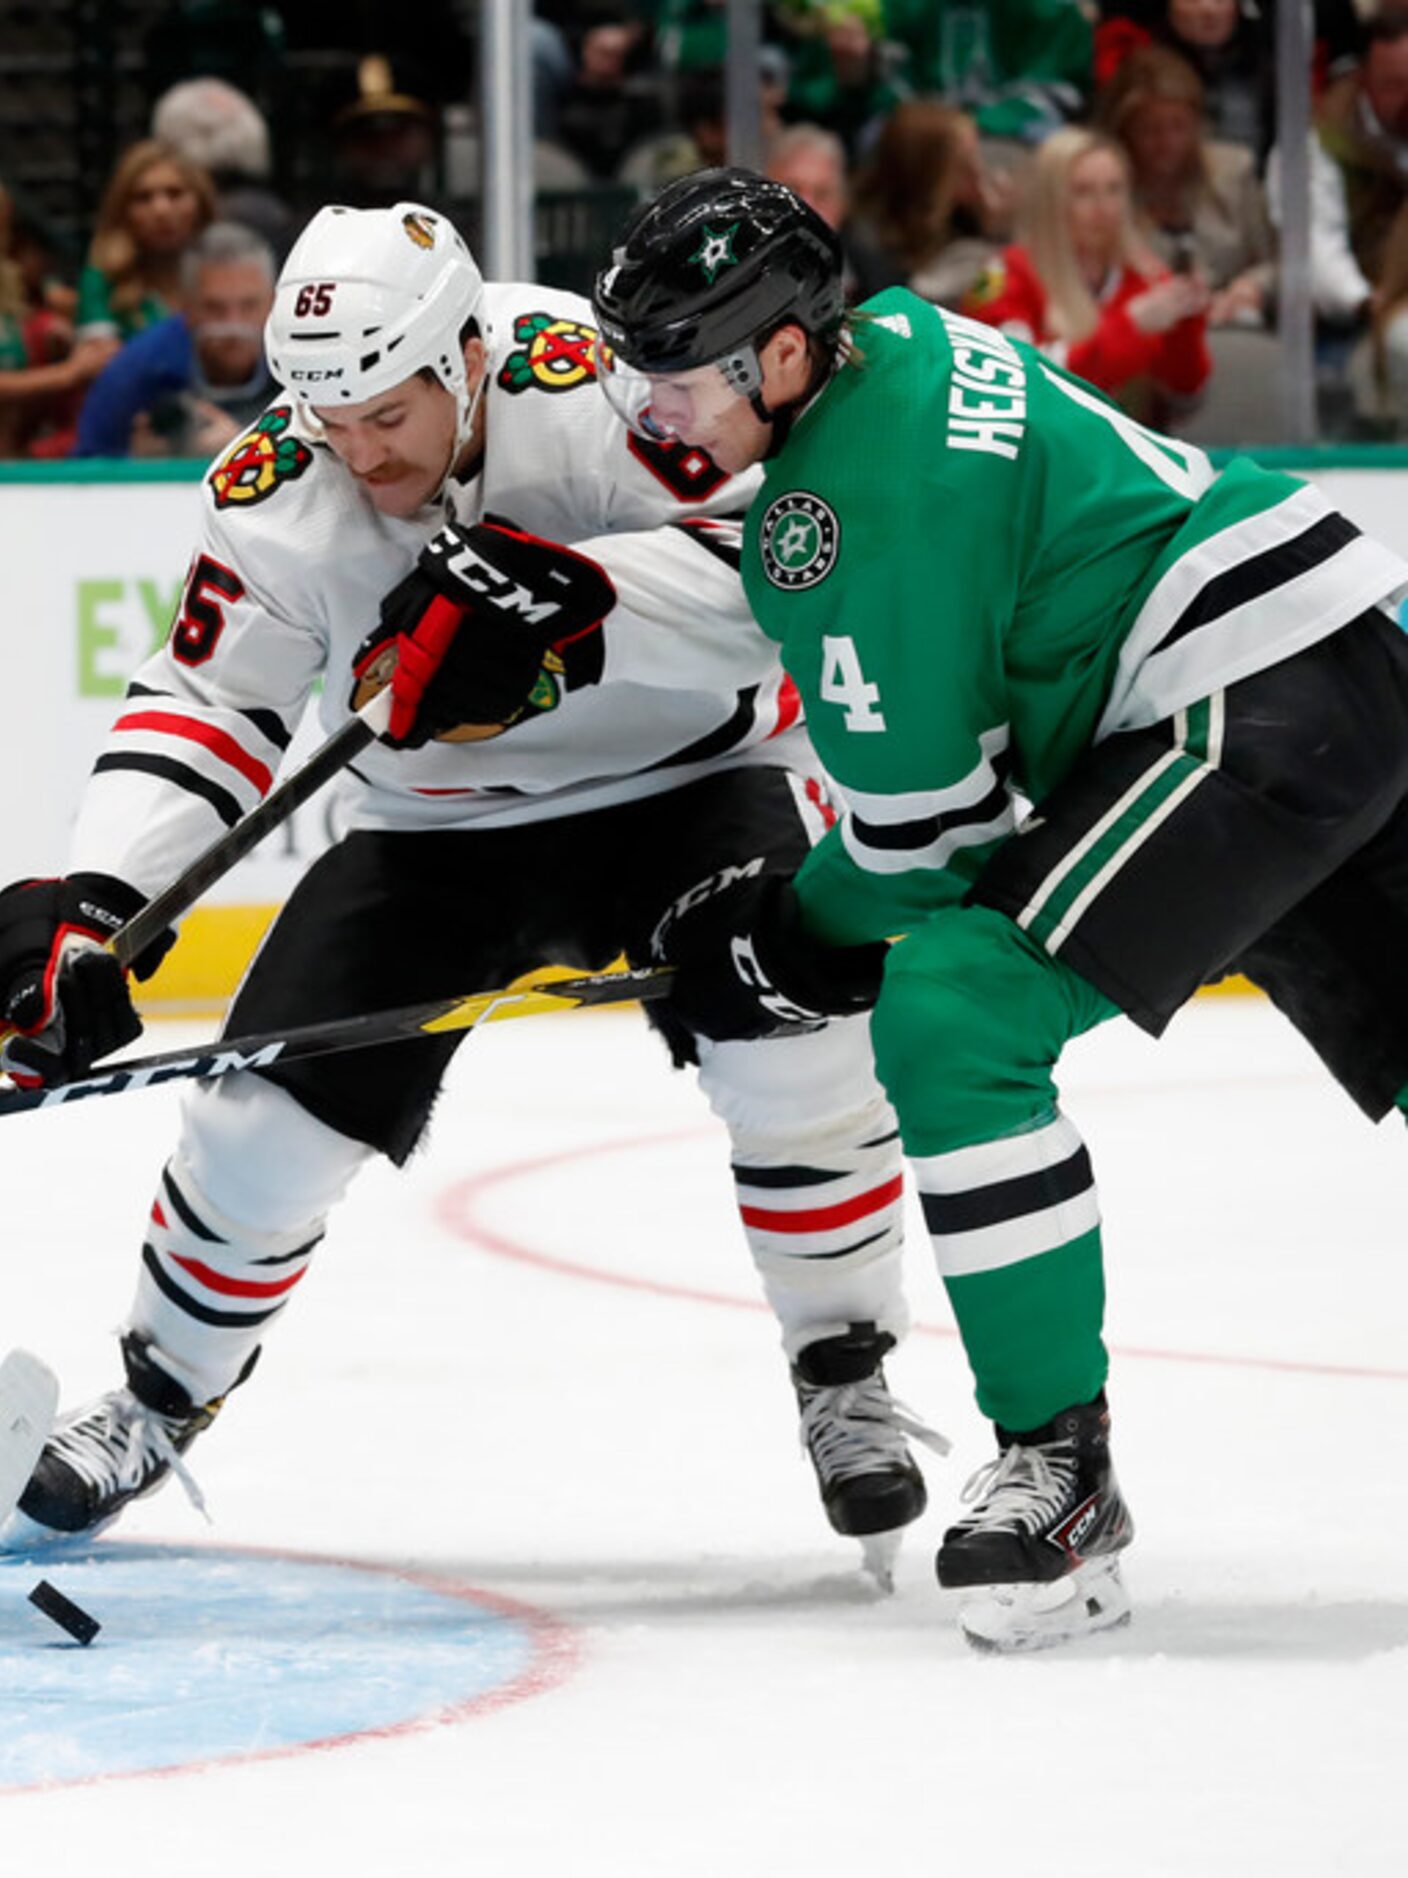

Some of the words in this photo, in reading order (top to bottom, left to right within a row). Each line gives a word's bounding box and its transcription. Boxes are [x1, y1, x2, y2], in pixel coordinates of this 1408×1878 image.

[294, 283, 336, 317] 65
[291, 367, 344, 382] CCM
[165, 552, 247, 669] 5
[428, 523, 563, 625] CCM
[820, 635, 887, 733] 4
[78, 900, 124, 927] CCM
[650, 857, 766, 963] CCM
[730, 932, 830, 1023] CC
[40, 1040, 287, 1109] CCM
[1066, 1503, 1096, 1547] CCM
